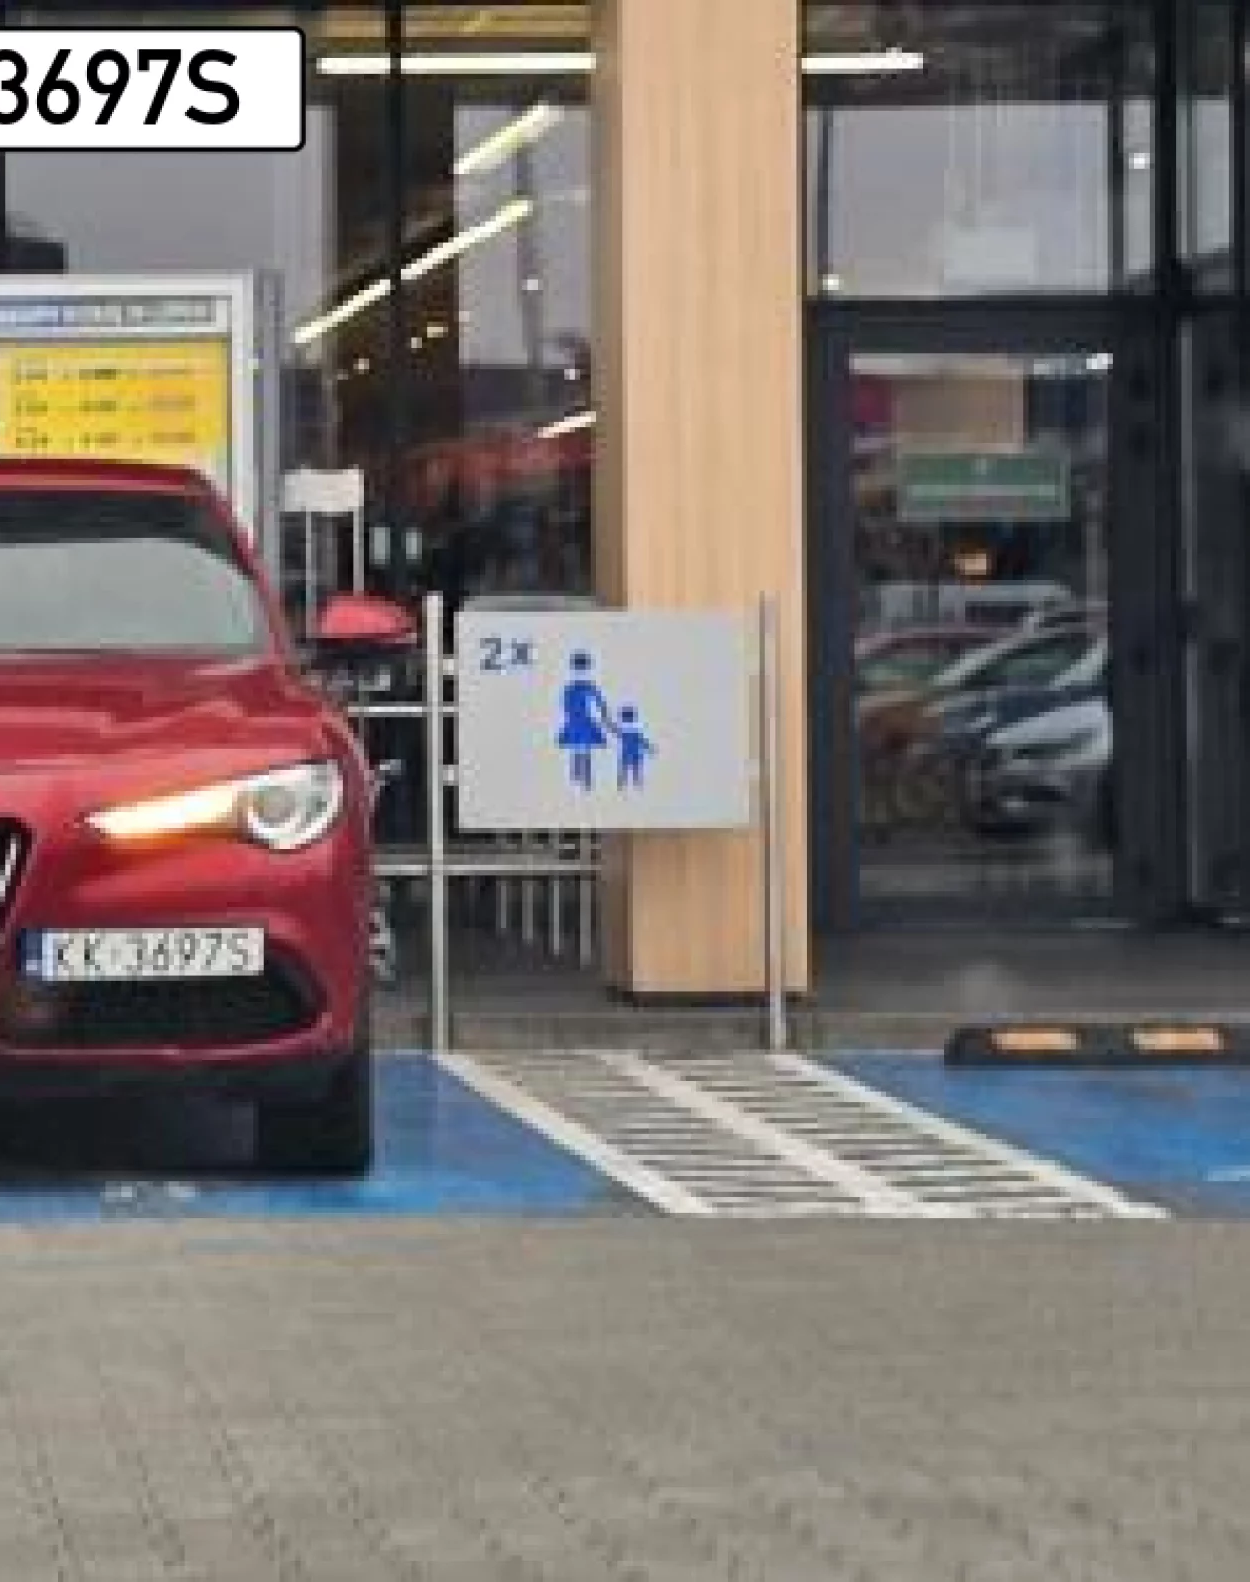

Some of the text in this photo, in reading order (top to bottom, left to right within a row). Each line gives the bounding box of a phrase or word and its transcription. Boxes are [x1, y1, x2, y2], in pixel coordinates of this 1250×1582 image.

[480, 638, 533, 671] 2x
[55, 932, 251, 971] KK 3697S
